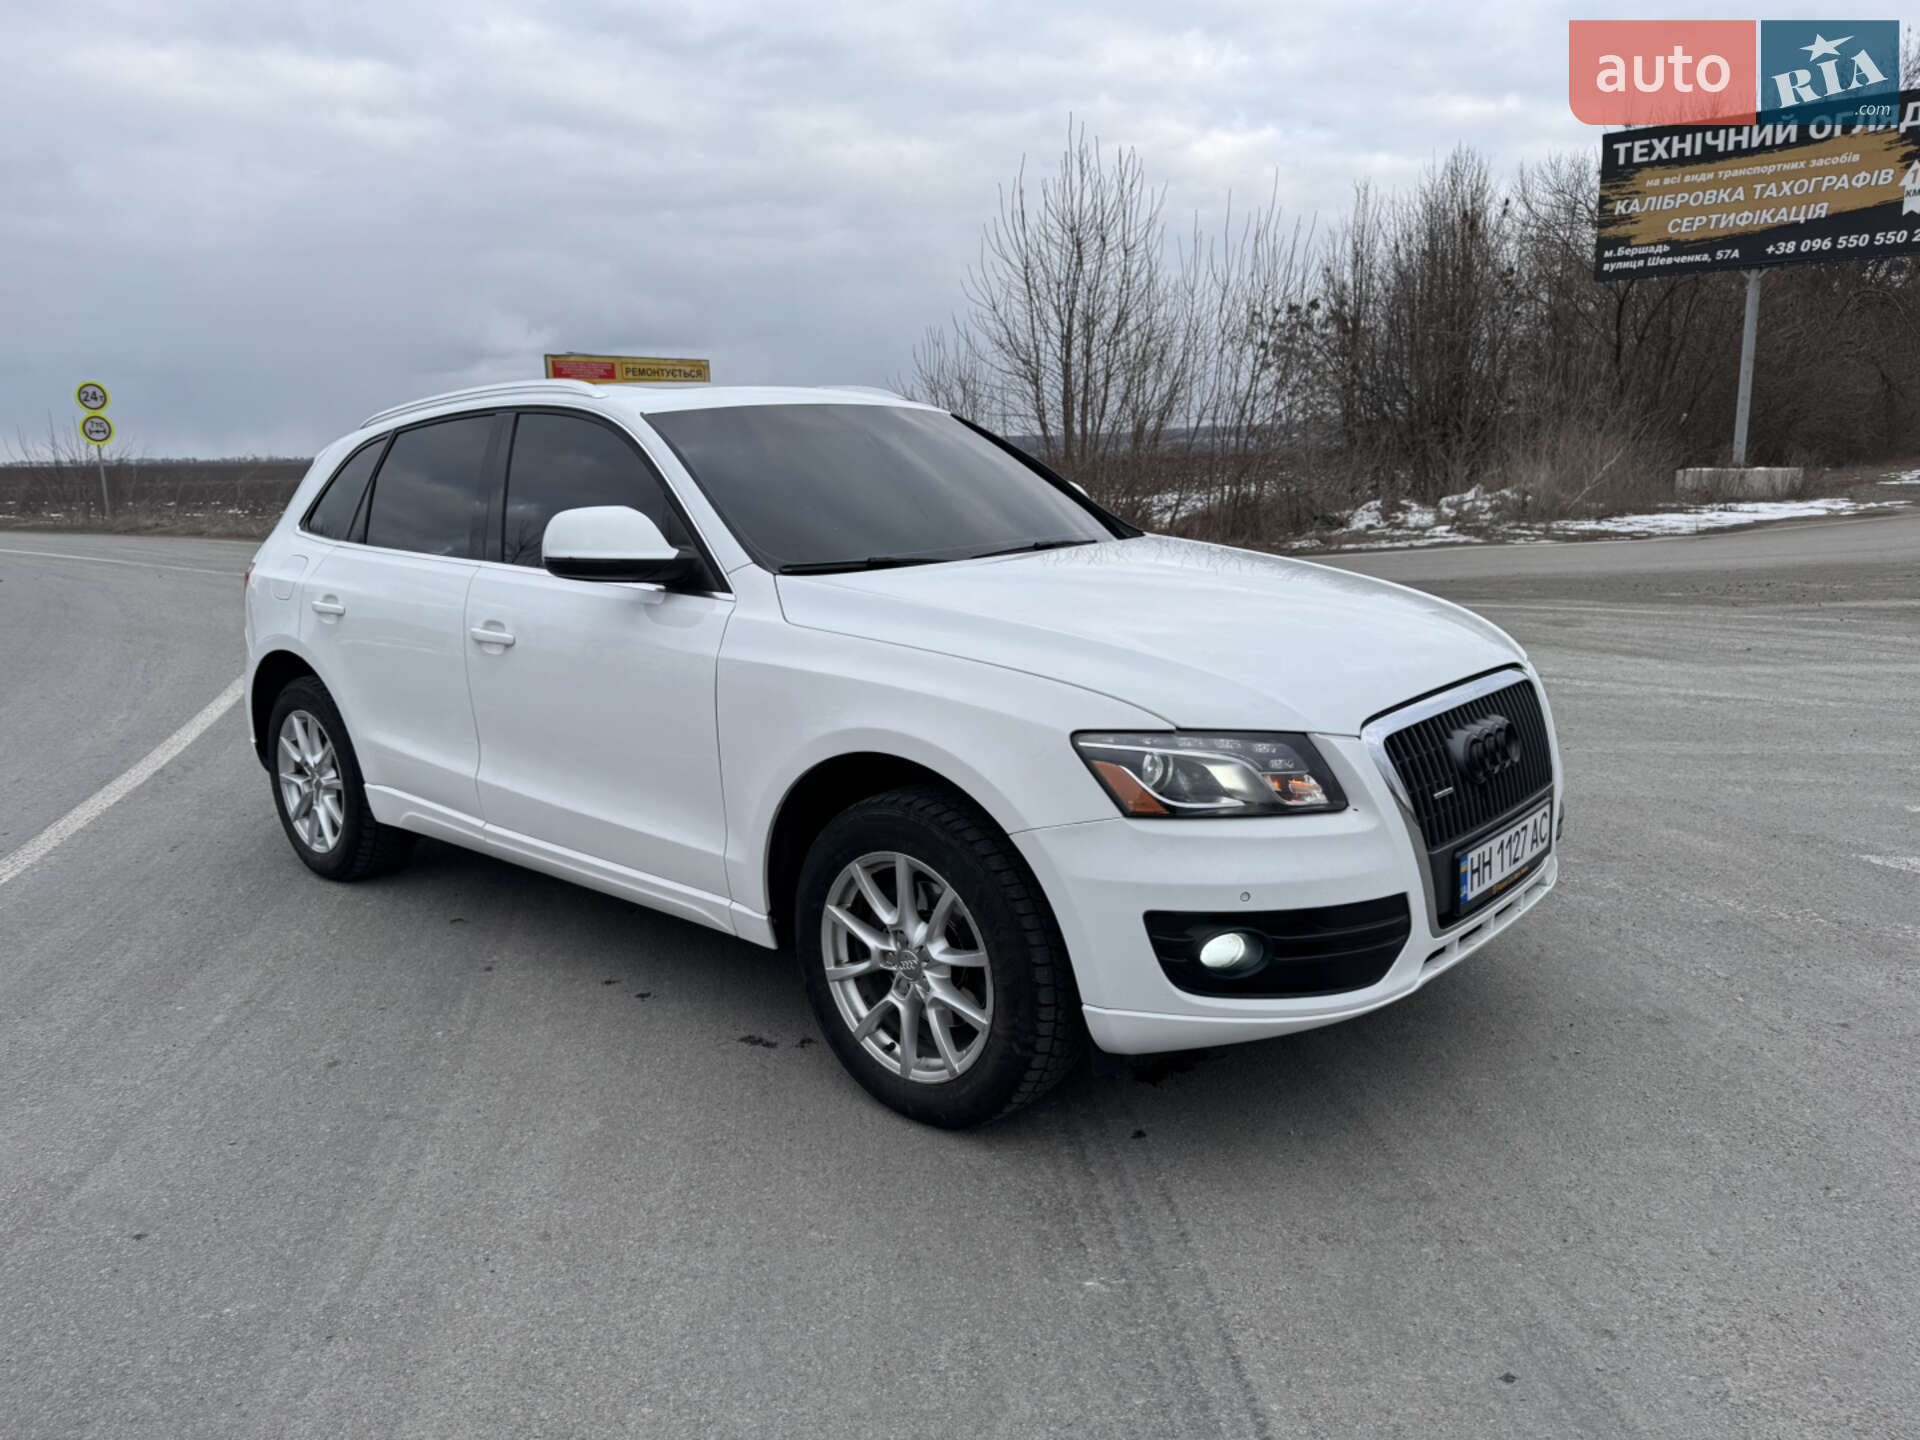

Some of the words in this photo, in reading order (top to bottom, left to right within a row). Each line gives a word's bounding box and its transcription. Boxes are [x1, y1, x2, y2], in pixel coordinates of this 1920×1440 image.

[1613, 113, 1798, 165] ТЕХНІЧНИЙ
[1645, 176, 1660, 187] на
[1663, 173, 1681, 185] всі
[1684, 171, 1714, 184] види
[1717, 160, 1806, 181] транспортних
[1809, 152, 1860, 168] засобів
[1614, 181, 1745, 216] КАЛІБРОВКА
[1753, 168, 1895, 200] ТАХОГРАФІВ
[1667, 202, 1829, 235] СЕРТИФІКАЦІЯ
[1765, 240, 1795, 256] +38
[1801, 237, 1832, 253] 096
[1836, 233, 1870, 249] 550
[1873, 230, 1908, 245] 550
[1602, 259, 1645, 273] вулиця
[1715, 249, 1740, 260] 57А
[625, 366, 704, 379] РЕМОНТУЄТЬСЯ
[1470, 846, 1493, 892] HH
[1497, 824, 1528, 872] 1127
[1530, 811, 1548, 852] AC
